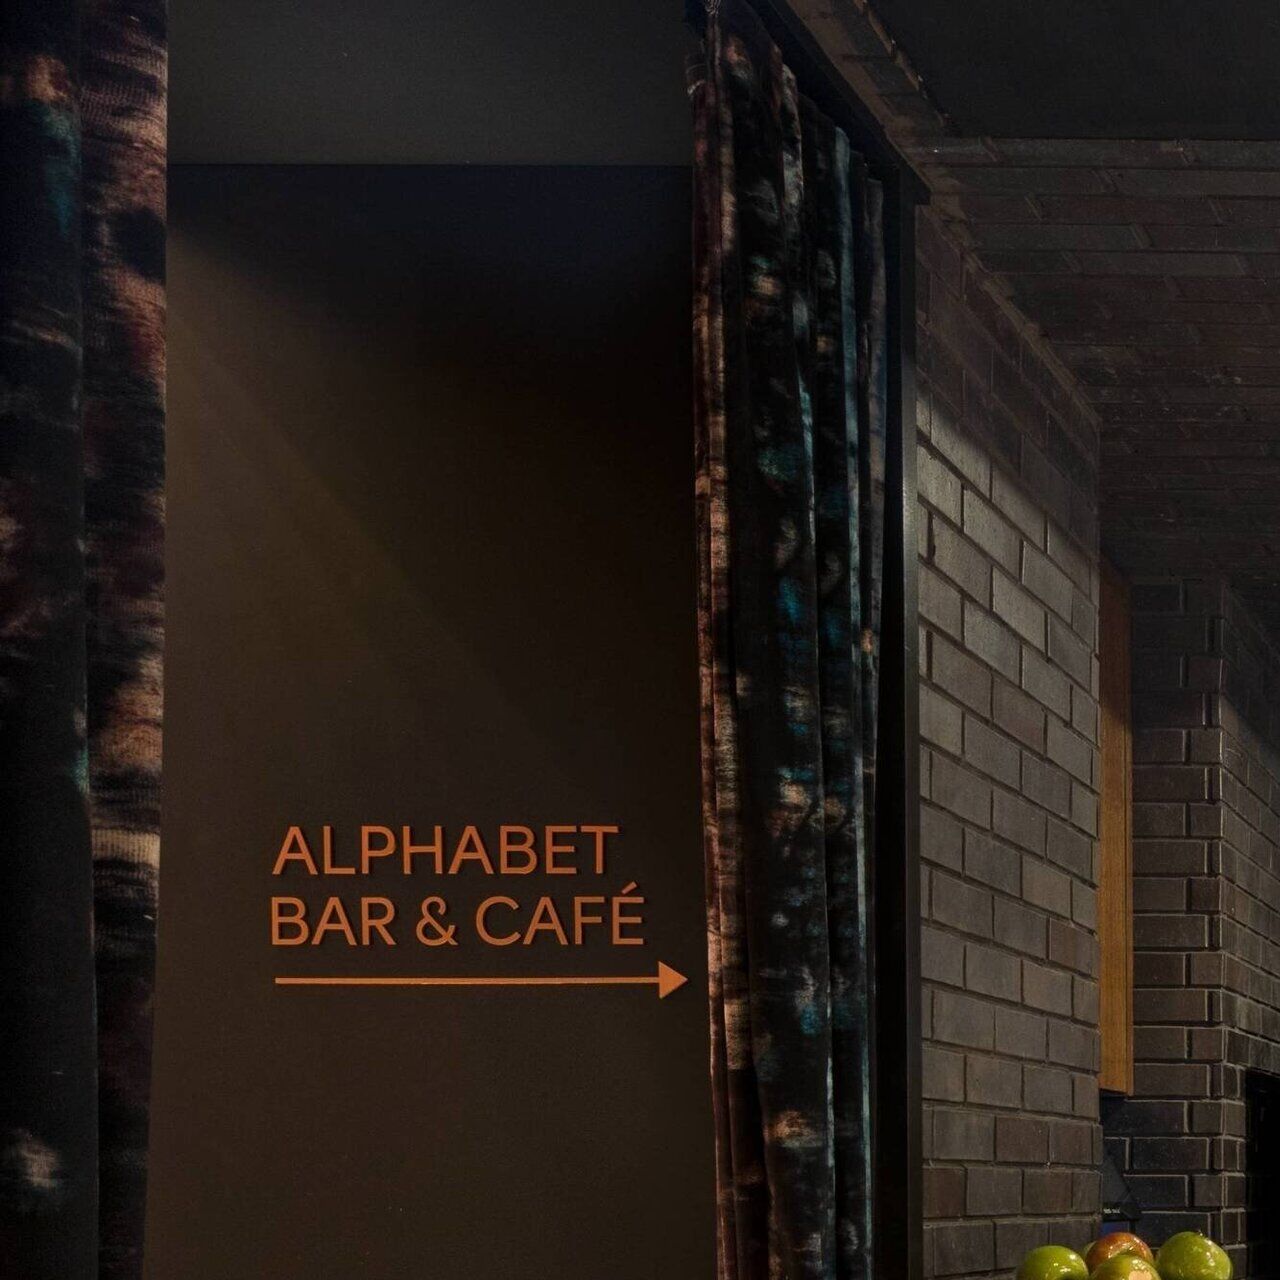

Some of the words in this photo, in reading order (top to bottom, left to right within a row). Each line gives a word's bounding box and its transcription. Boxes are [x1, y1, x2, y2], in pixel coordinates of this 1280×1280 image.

[272, 825, 620, 875] ALPHABET
[271, 896, 396, 946] BAR
[415, 896, 458, 946] &
[475, 881, 645, 946] CAFÉ
